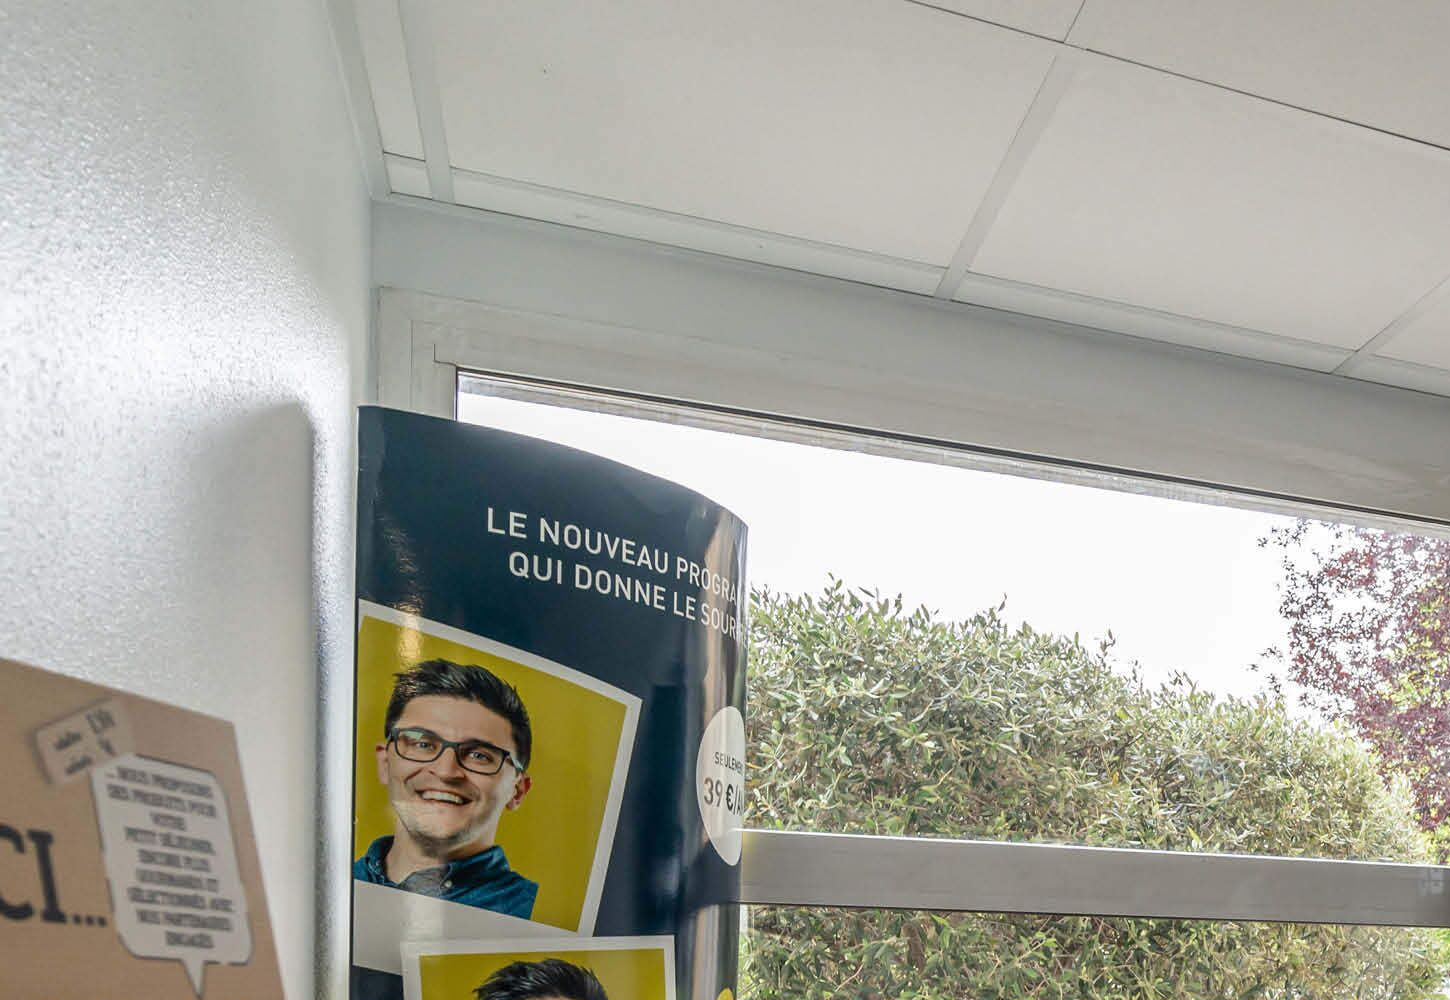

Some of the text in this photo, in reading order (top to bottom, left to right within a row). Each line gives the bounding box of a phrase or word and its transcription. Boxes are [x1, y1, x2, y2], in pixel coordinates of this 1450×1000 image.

[487, 507, 746, 608] LE NOUVEAU PROGRA
[509, 551, 563, 585] QUI
[574, 563, 666, 611] DONNE
[673, 591, 697, 621] LE
[703, 776, 723, 808] 39
